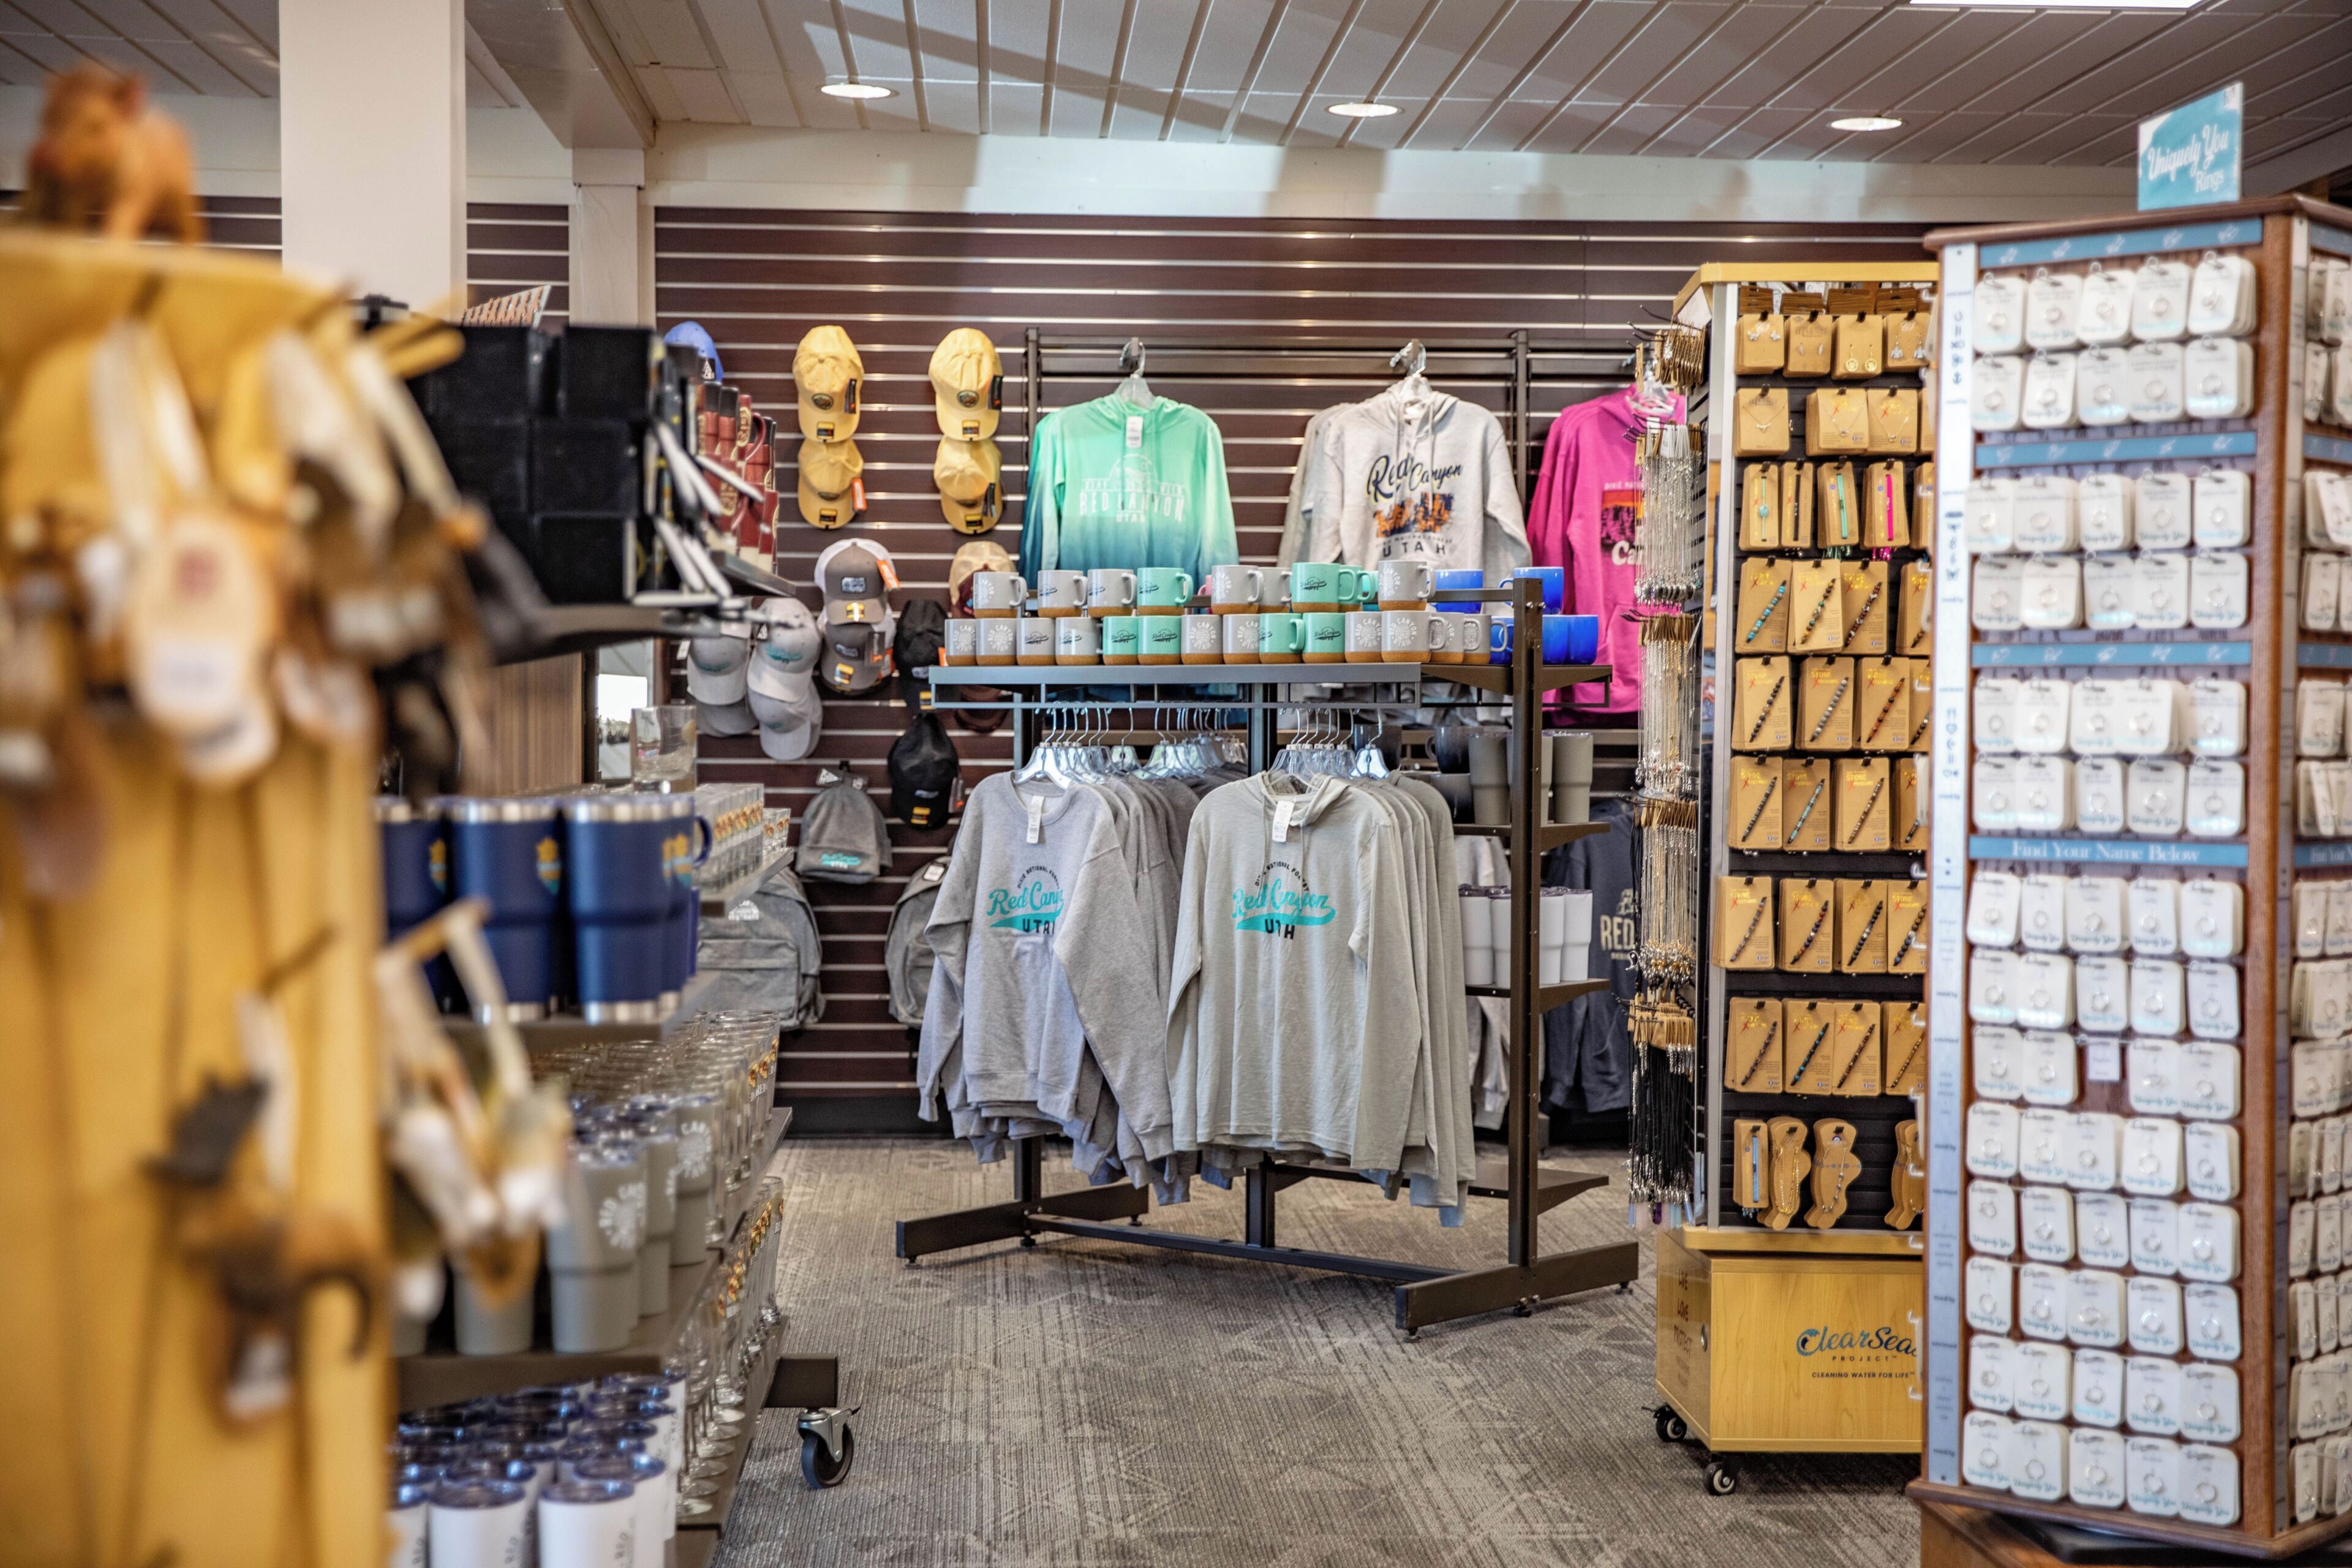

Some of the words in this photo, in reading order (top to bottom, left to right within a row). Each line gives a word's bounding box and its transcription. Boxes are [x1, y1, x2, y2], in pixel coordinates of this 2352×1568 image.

[2148, 134, 2201, 181] Uniquely
[2203, 125, 2229, 169] You
[2195, 170, 2224, 192] Rings
[1367, 452, 1414, 502] Red
[1409, 463, 1461, 491] Canyon
[1080, 492, 1109, 515] RED
[1383, 541, 1445, 557] UTAH
[995, 625, 1013, 640] CANYON
[1197, 622, 1216, 639] CANYON
[1396, 617, 1417, 635] CANYON
[2012, 842, 2047, 858] Find
[2052, 842, 2090, 859] Your
[2097, 844, 2143, 860] Name
[2149, 845, 2199, 862] Below
[1267, 861, 1289, 870] NATIONAL
[987, 887, 1028, 916] Red
[1232, 884, 1268, 918] Red
[1600, 914, 1635, 951] RED
[2054, 1166, 2064, 1175] Yo
[2130, 1412, 2161, 1426] Uniquely
[2184, 1422, 2215, 1433] Uniquely
[2013, 1479, 2043, 1491] Uniquely
[2073, 1485, 2105, 1498] Uniquely
[2181, 1501, 2214, 1514] Uniquely
[615, 1532, 628, 1559] RED
